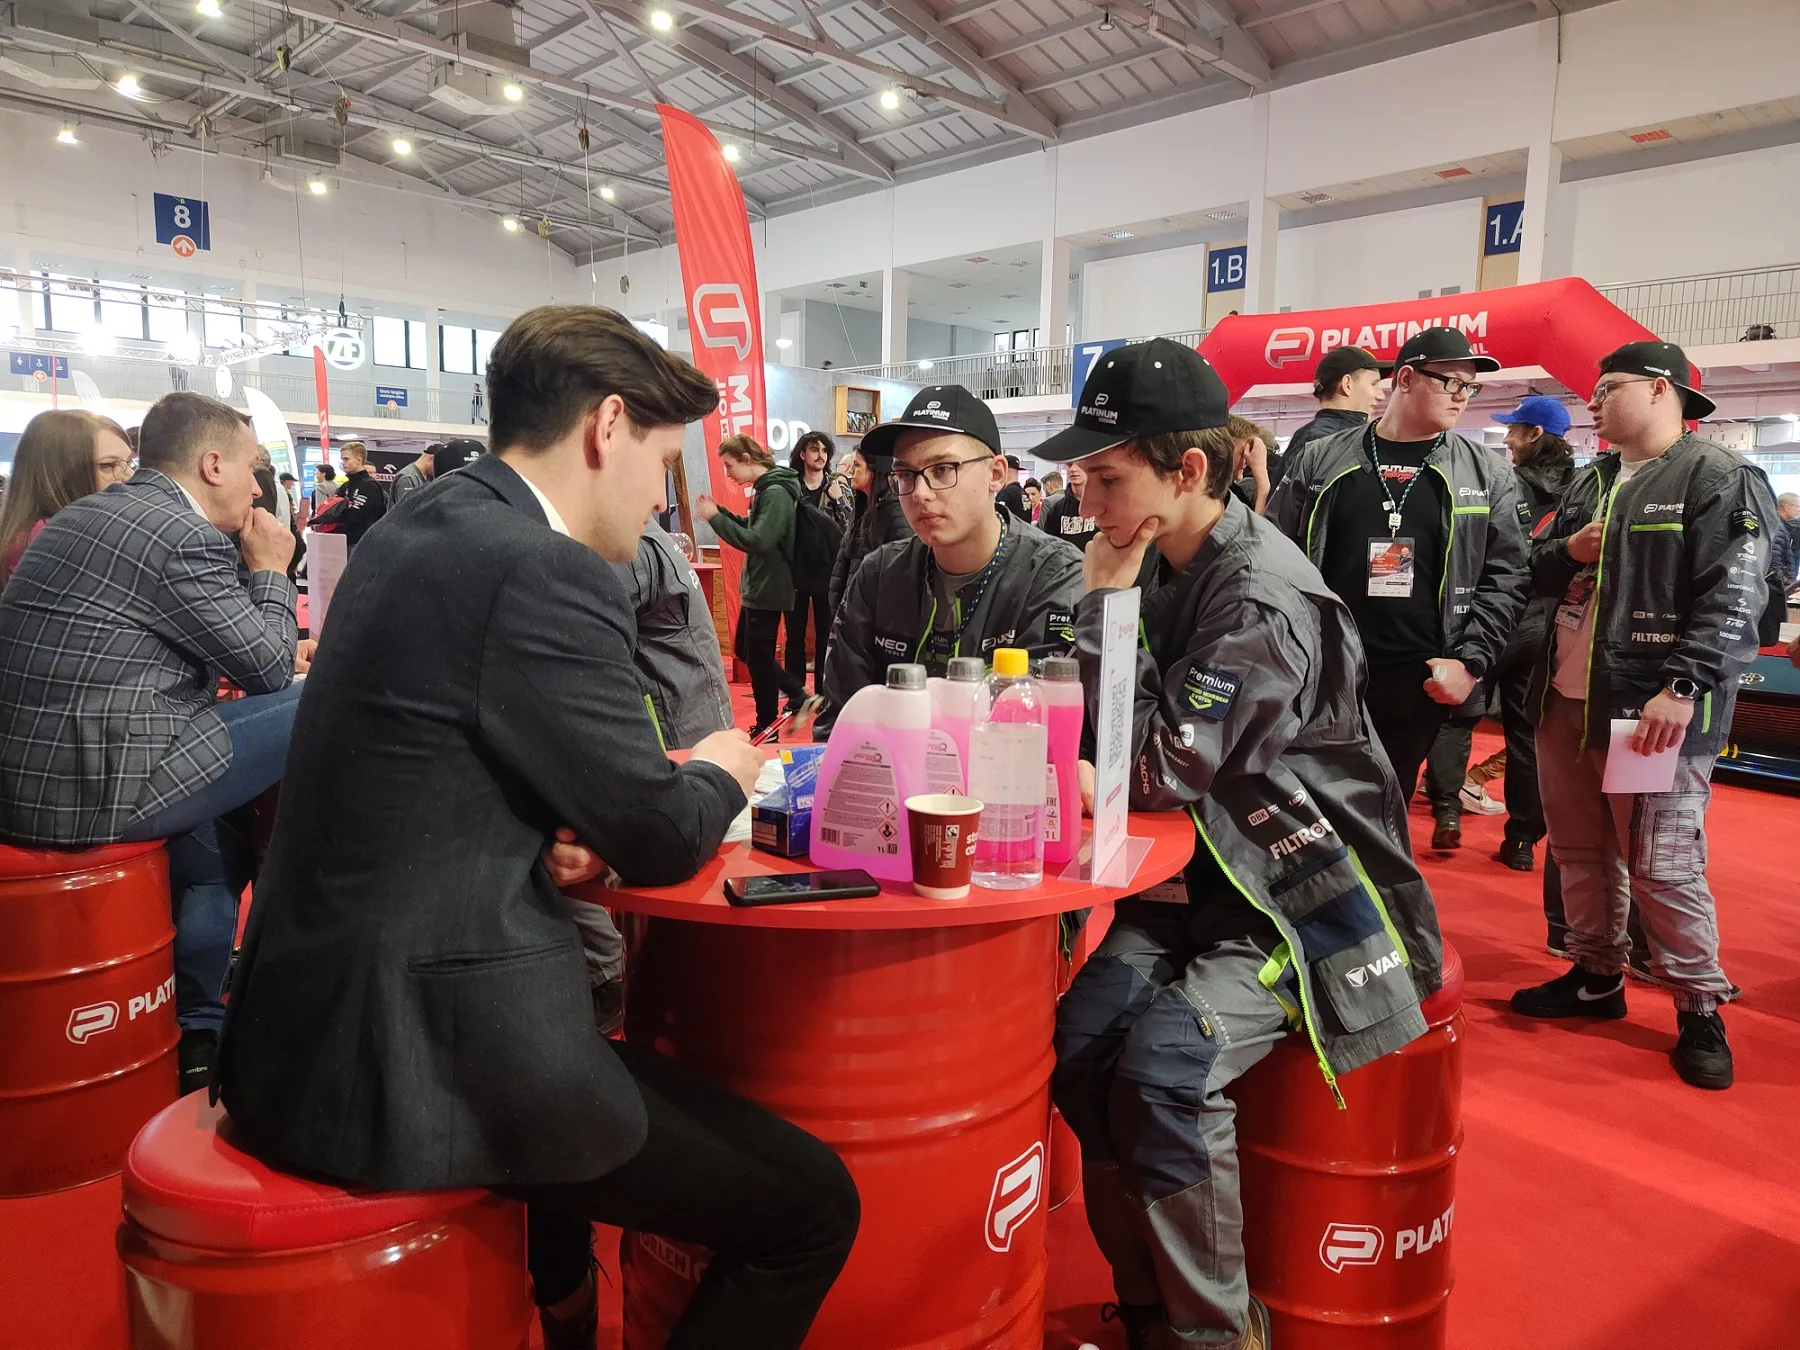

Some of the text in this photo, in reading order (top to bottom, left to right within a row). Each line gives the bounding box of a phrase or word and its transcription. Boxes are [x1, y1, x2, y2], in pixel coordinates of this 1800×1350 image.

[174, 204, 191, 229] 8
[1211, 254, 1243, 285] 1.B
[1083, 346, 1103, 382] 7
[913, 409, 950, 418] PLATINUM
[1081, 406, 1118, 420] PLATINUM
[875, 635, 907, 651] NEO
[1140, 754, 1150, 795] SACHS
[1249, 810, 1268, 824] DBK
